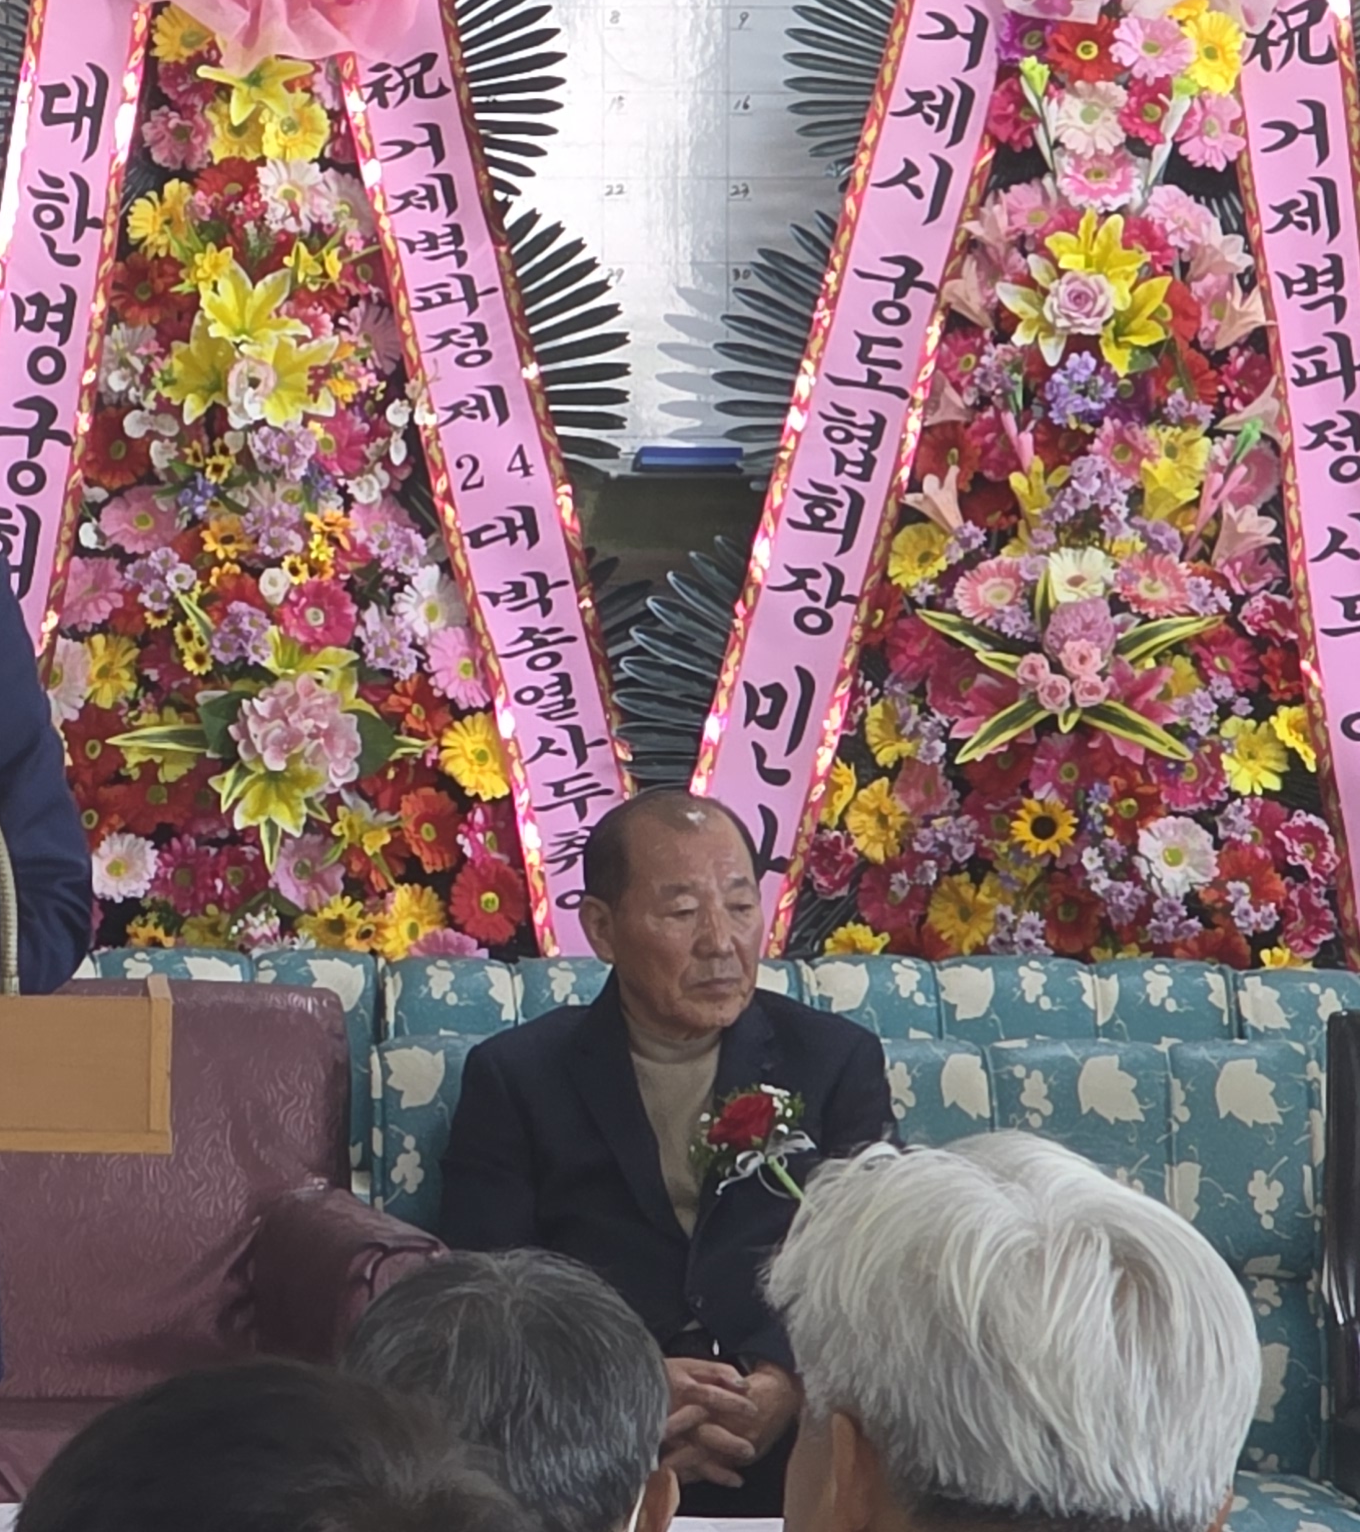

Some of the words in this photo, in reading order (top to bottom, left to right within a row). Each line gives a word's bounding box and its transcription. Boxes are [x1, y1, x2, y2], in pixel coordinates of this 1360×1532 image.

[738, 11, 750, 30] 9
[362, 52, 452, 110] 祝
[733, 94, 751, 111] 16
[871, 4, 989, 226] 거제시
[604, 183, 626, 196] 22
